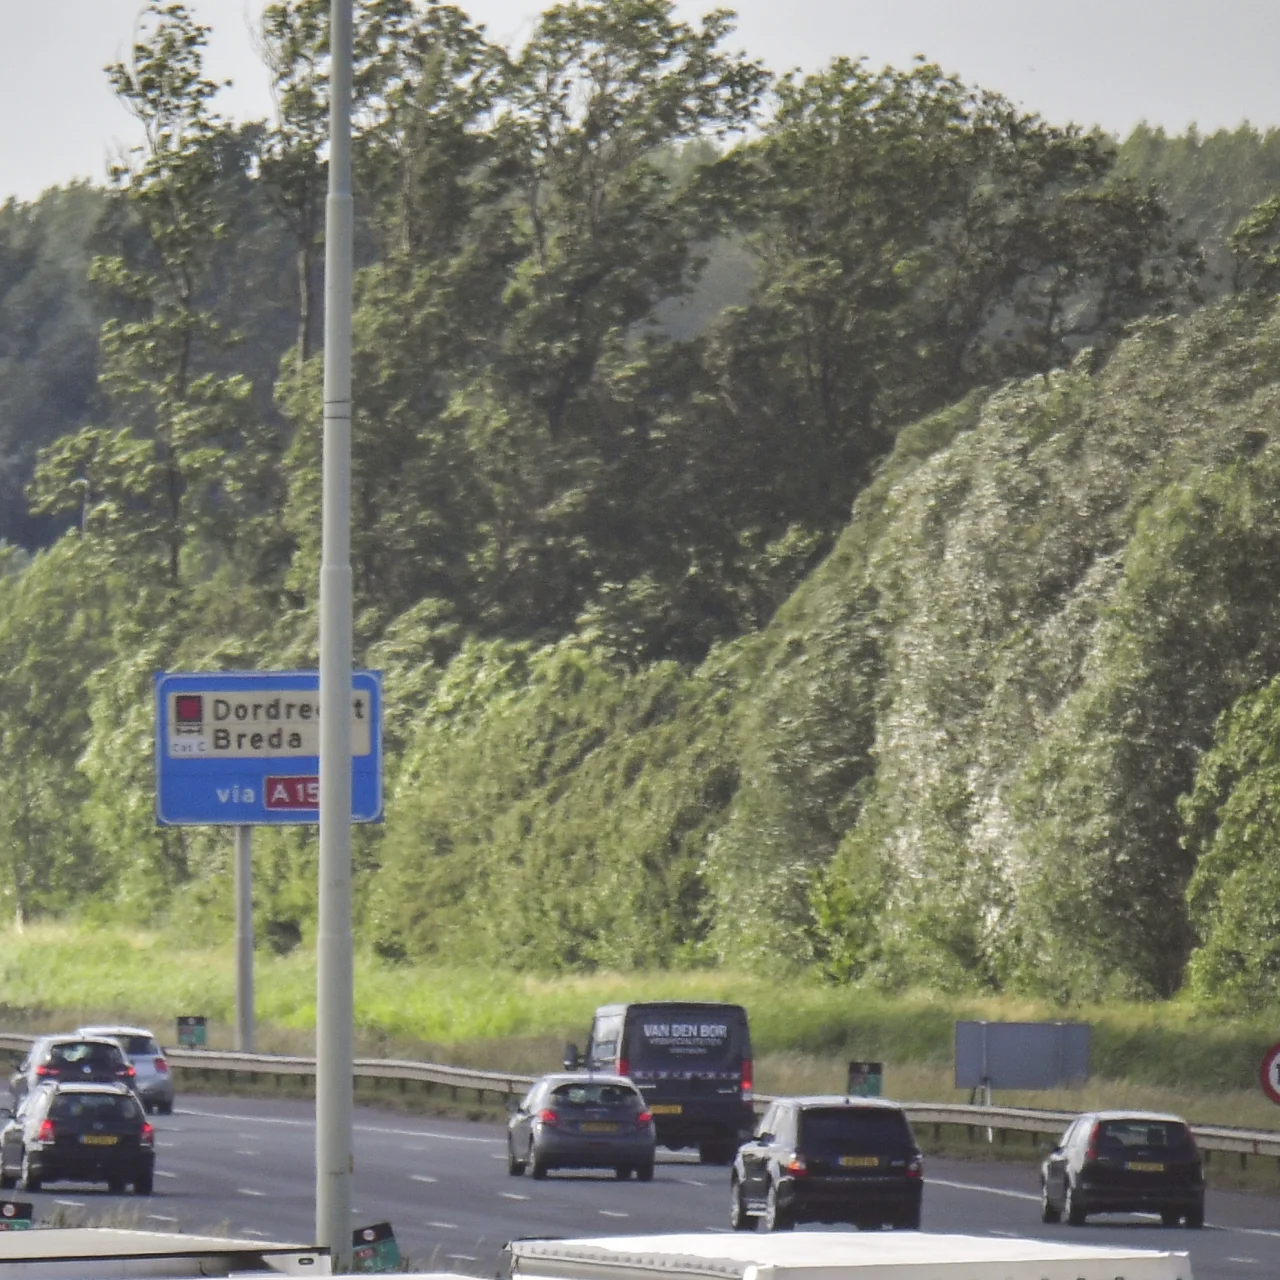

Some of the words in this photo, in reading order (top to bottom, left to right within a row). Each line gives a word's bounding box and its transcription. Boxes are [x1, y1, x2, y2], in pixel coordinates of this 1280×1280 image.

[212, 698, 365, 721] Dordret
[213, 727, 303, 750] Breda
[215, 785, 256, 803] via
[643, 1023, 670, 1038] VAN
[671, 1024, 698, 1038] DEN
